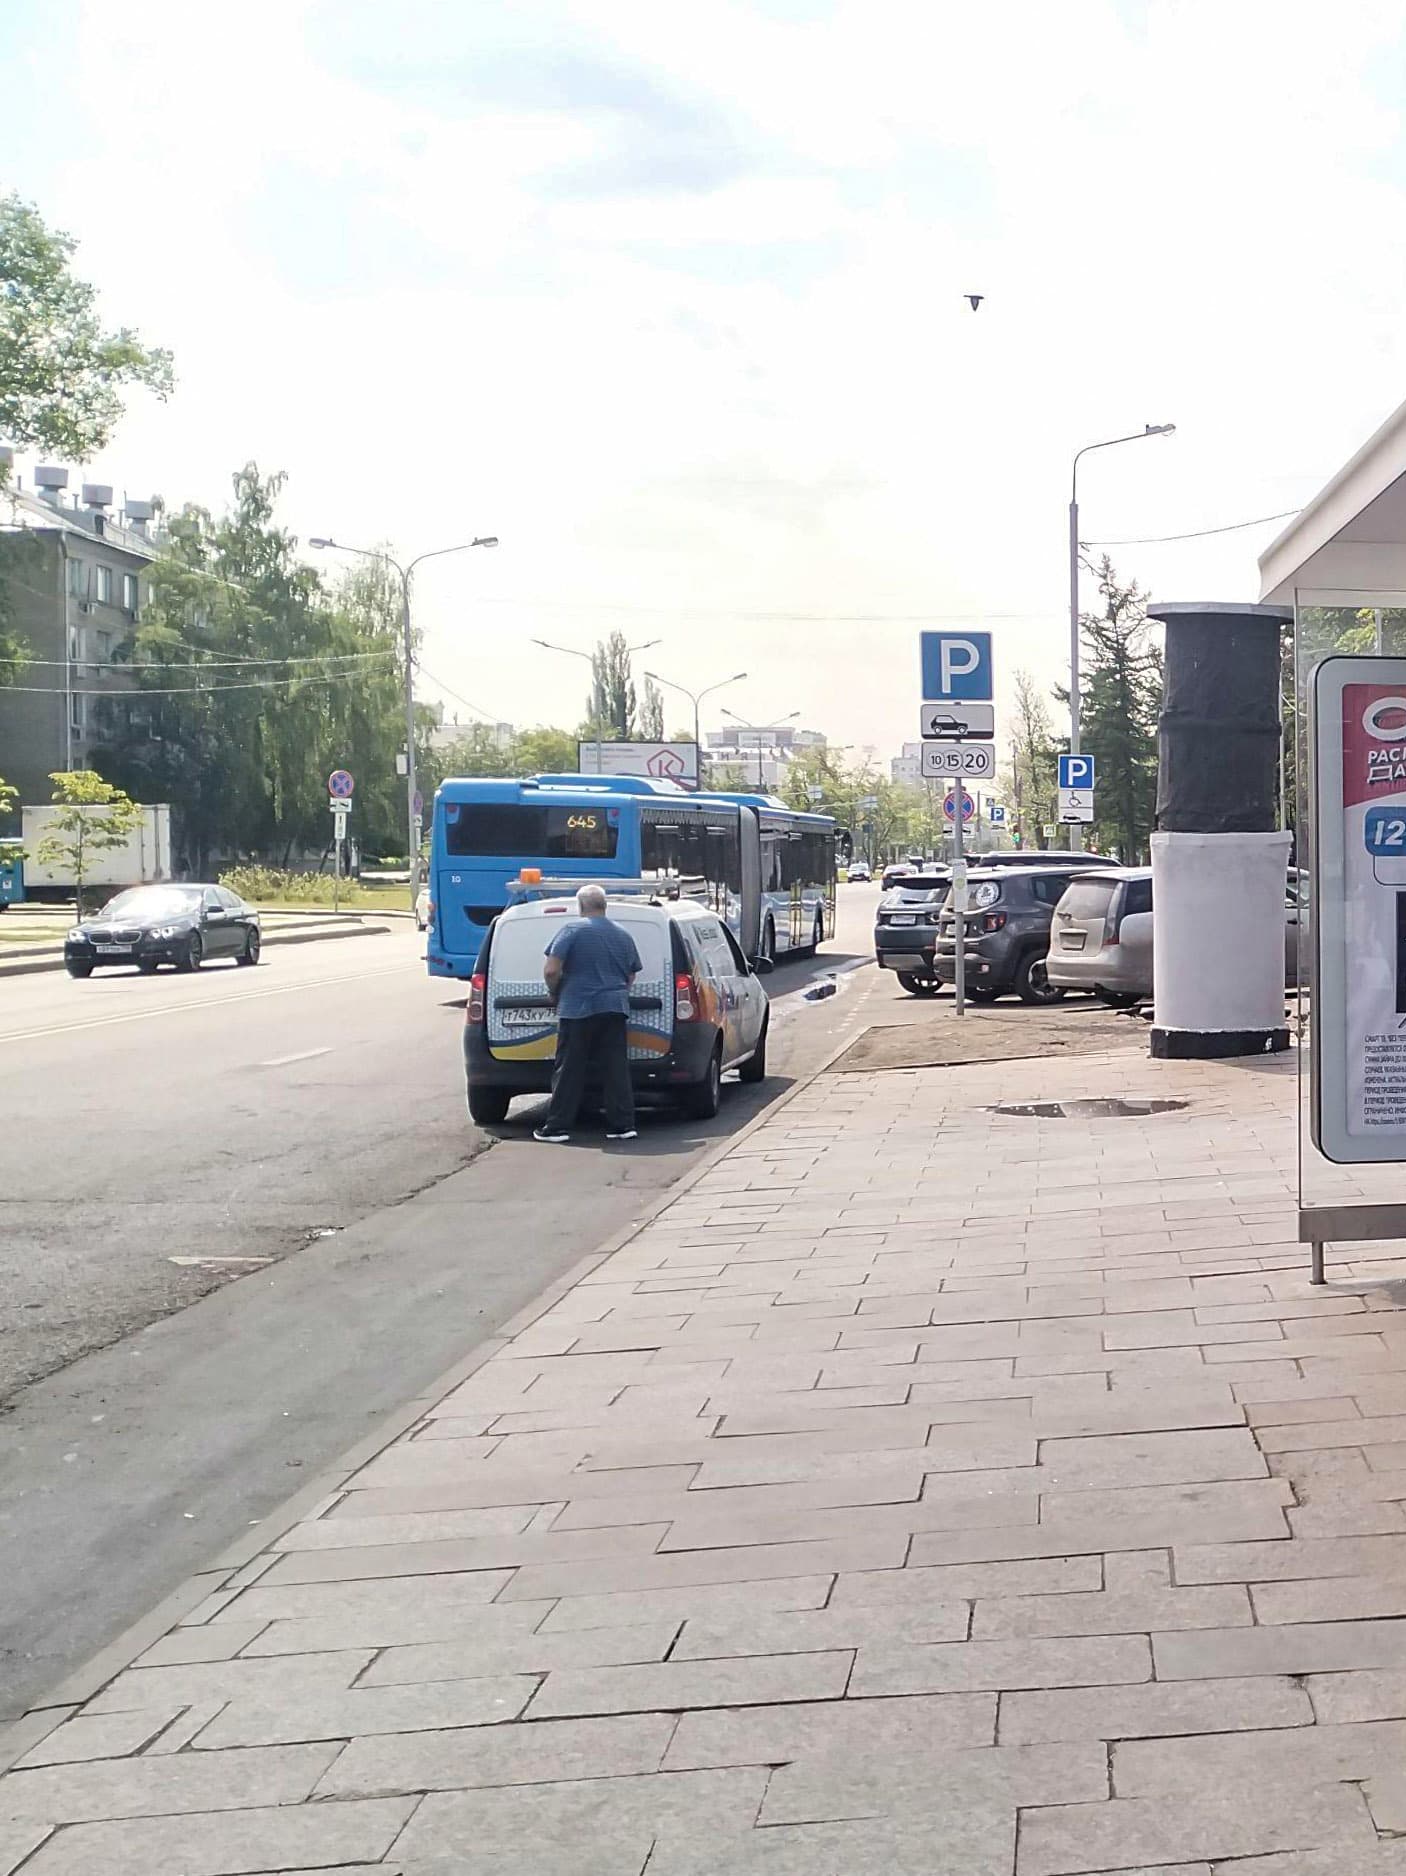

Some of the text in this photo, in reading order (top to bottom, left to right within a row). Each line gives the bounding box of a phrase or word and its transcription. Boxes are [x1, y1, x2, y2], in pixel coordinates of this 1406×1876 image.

[941, 640, 980, 694] P
[931, 754, 986, 769] 10 15 20
[1068, 759, 1088, 786] P
[567, 815, 597, 829] 645
[993, 808, 1003, 820] P
[1374, 820, 1405, 846] 12
